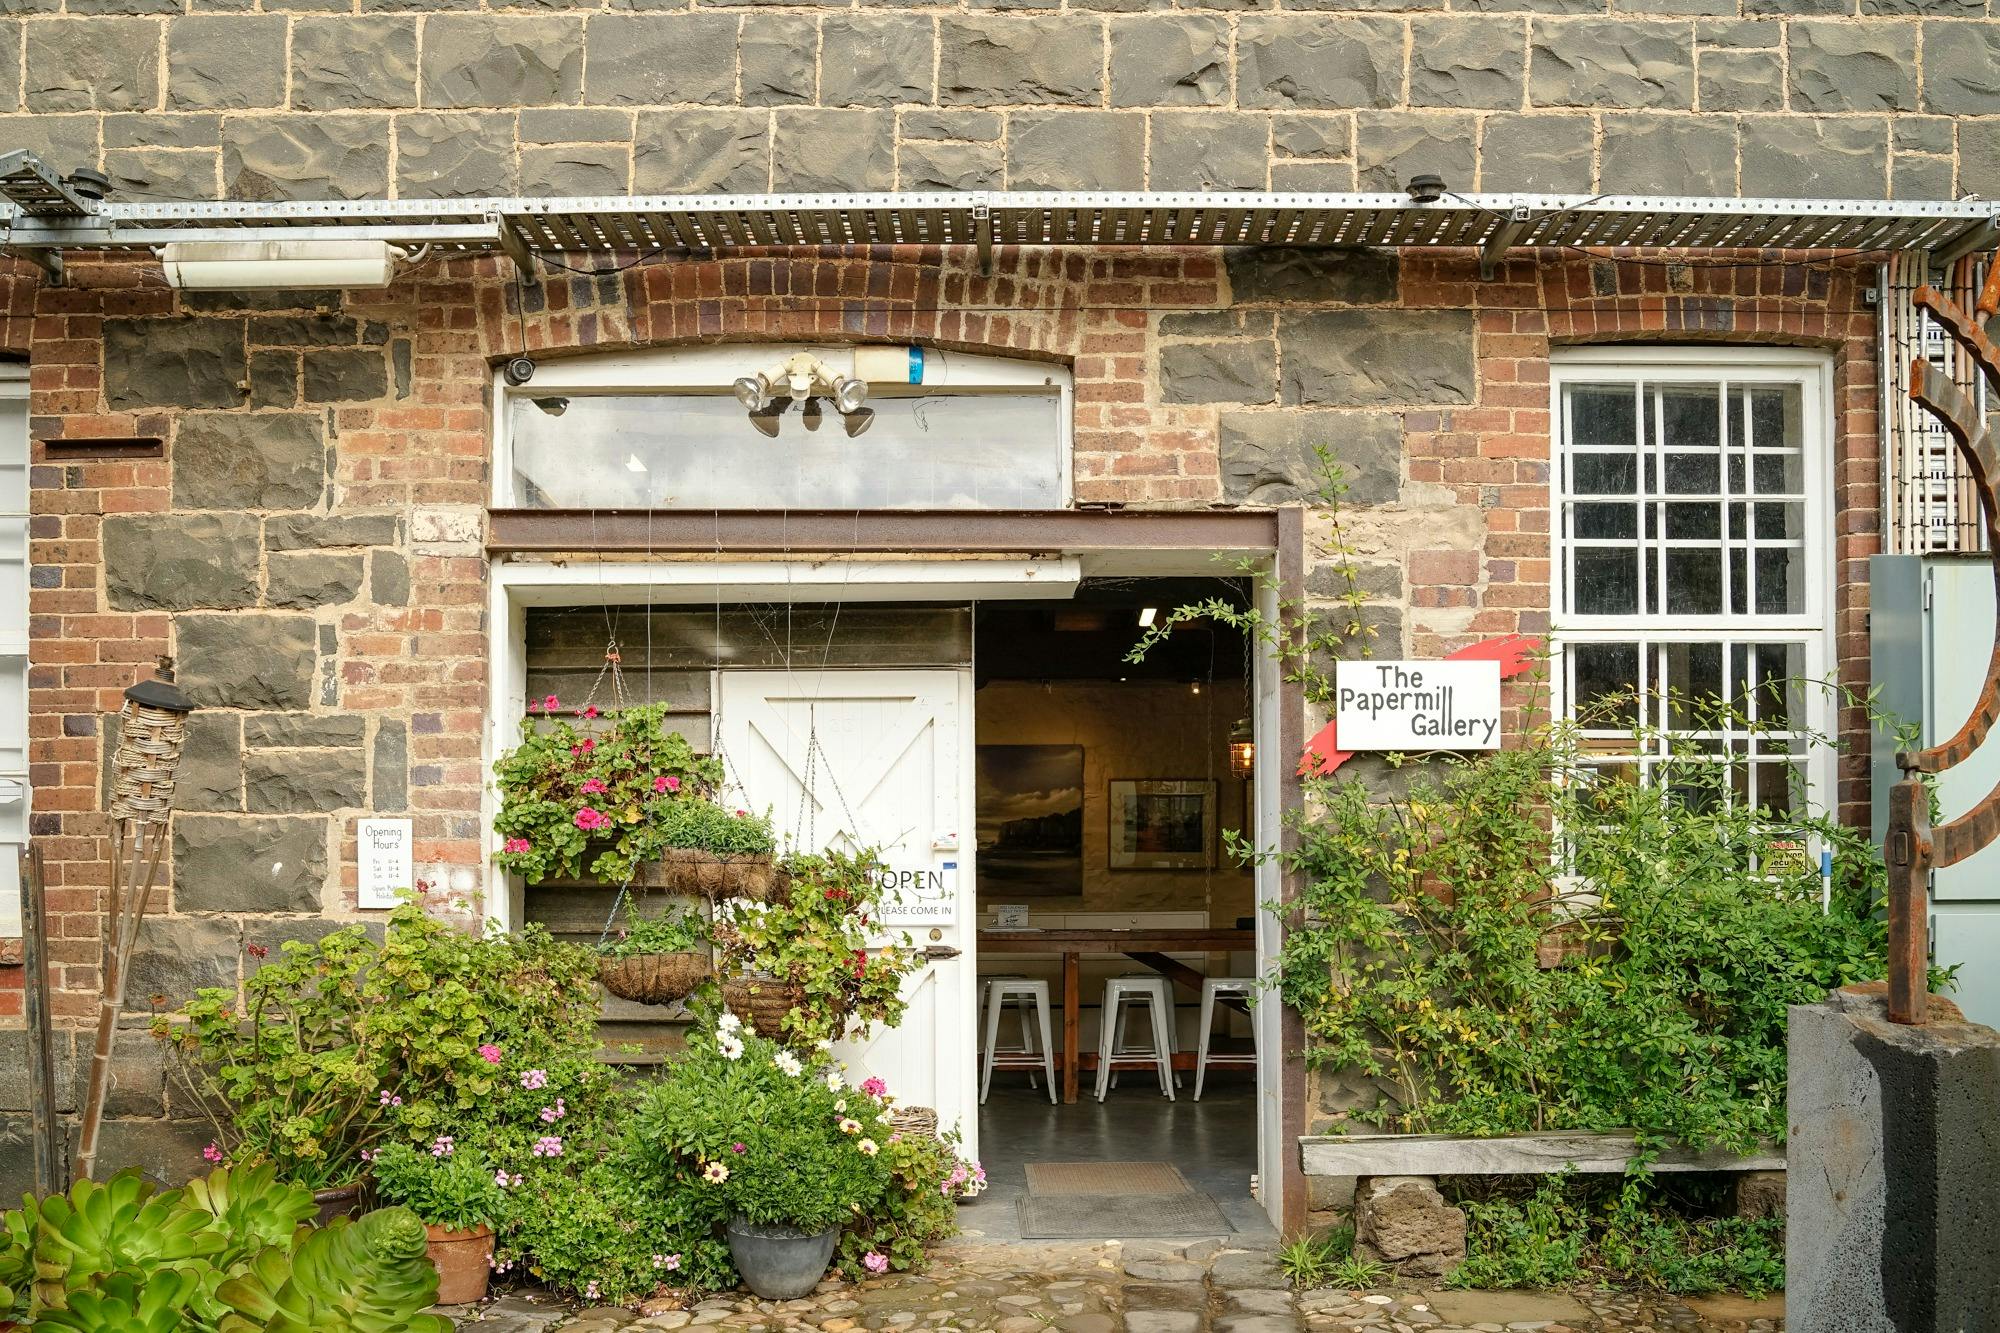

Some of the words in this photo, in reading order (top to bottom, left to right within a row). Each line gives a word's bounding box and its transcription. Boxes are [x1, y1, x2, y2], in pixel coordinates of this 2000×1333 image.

[1376, 665, 1424, 688] The
[1340, 686, 1453, 727] Papermill
[1411, 708, 1498, 745] Gallery
[365, 824, 402, 841] Opening
[373, 838, 399, 849] Hours
[881, 870, 943, 889] OPEN
[876, 906, 908, 915] PLEASE
[910, 906, 939, 915] COME
[941, 906, 952, 915] IN
